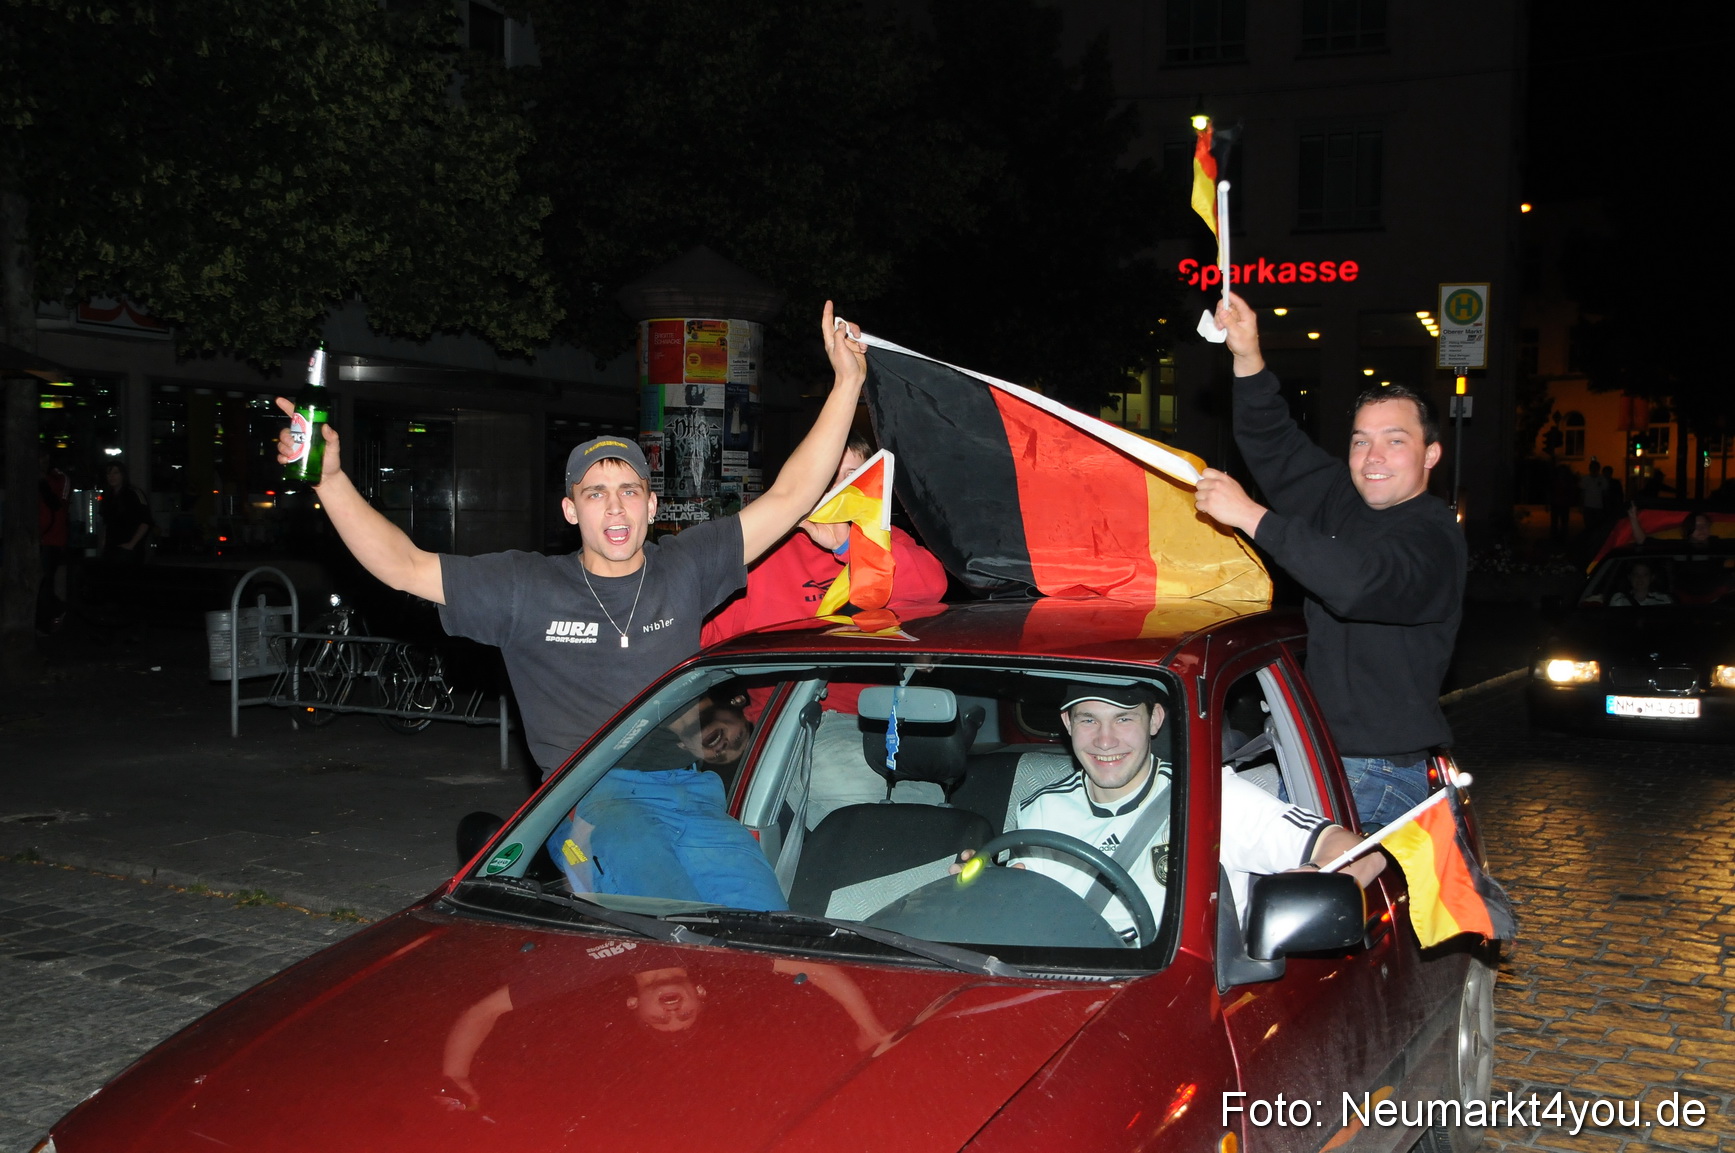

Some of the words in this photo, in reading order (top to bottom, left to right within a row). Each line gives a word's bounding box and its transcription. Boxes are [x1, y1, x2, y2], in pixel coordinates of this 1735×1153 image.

[1178, 257, 1359, 291] Sparkasse
[546, 620, 599, 636] JURA
[642, 618, 674, 633] Nibler
[1668, 702, 1696, 715] 610
